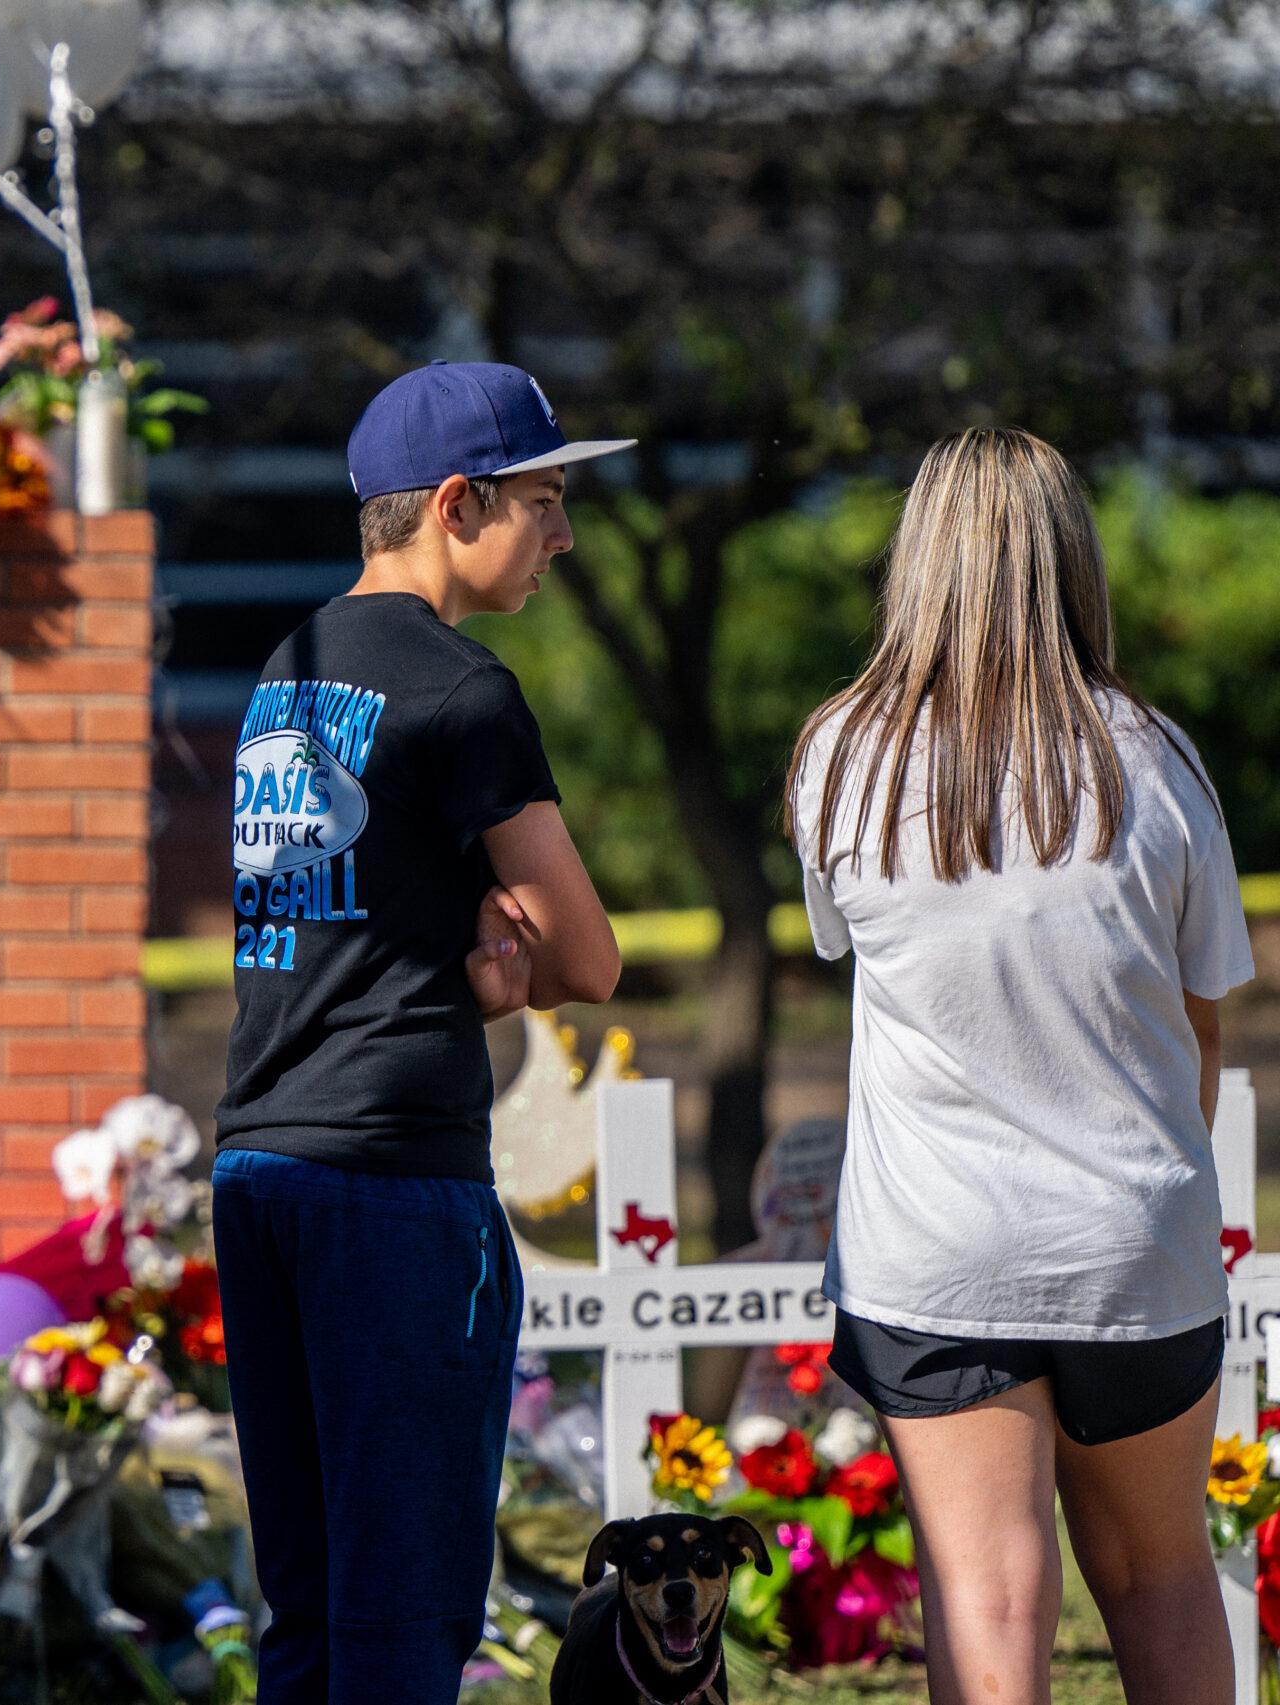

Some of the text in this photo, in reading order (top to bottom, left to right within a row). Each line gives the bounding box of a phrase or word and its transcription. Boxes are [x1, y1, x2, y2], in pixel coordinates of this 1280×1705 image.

[310, 680, 387, 779] BLIZZARD
[234, 762, 332, 817] OASIS
[266, 848, 369, 921] GRILL
[631, 1287, 827, 1329] Cazare
